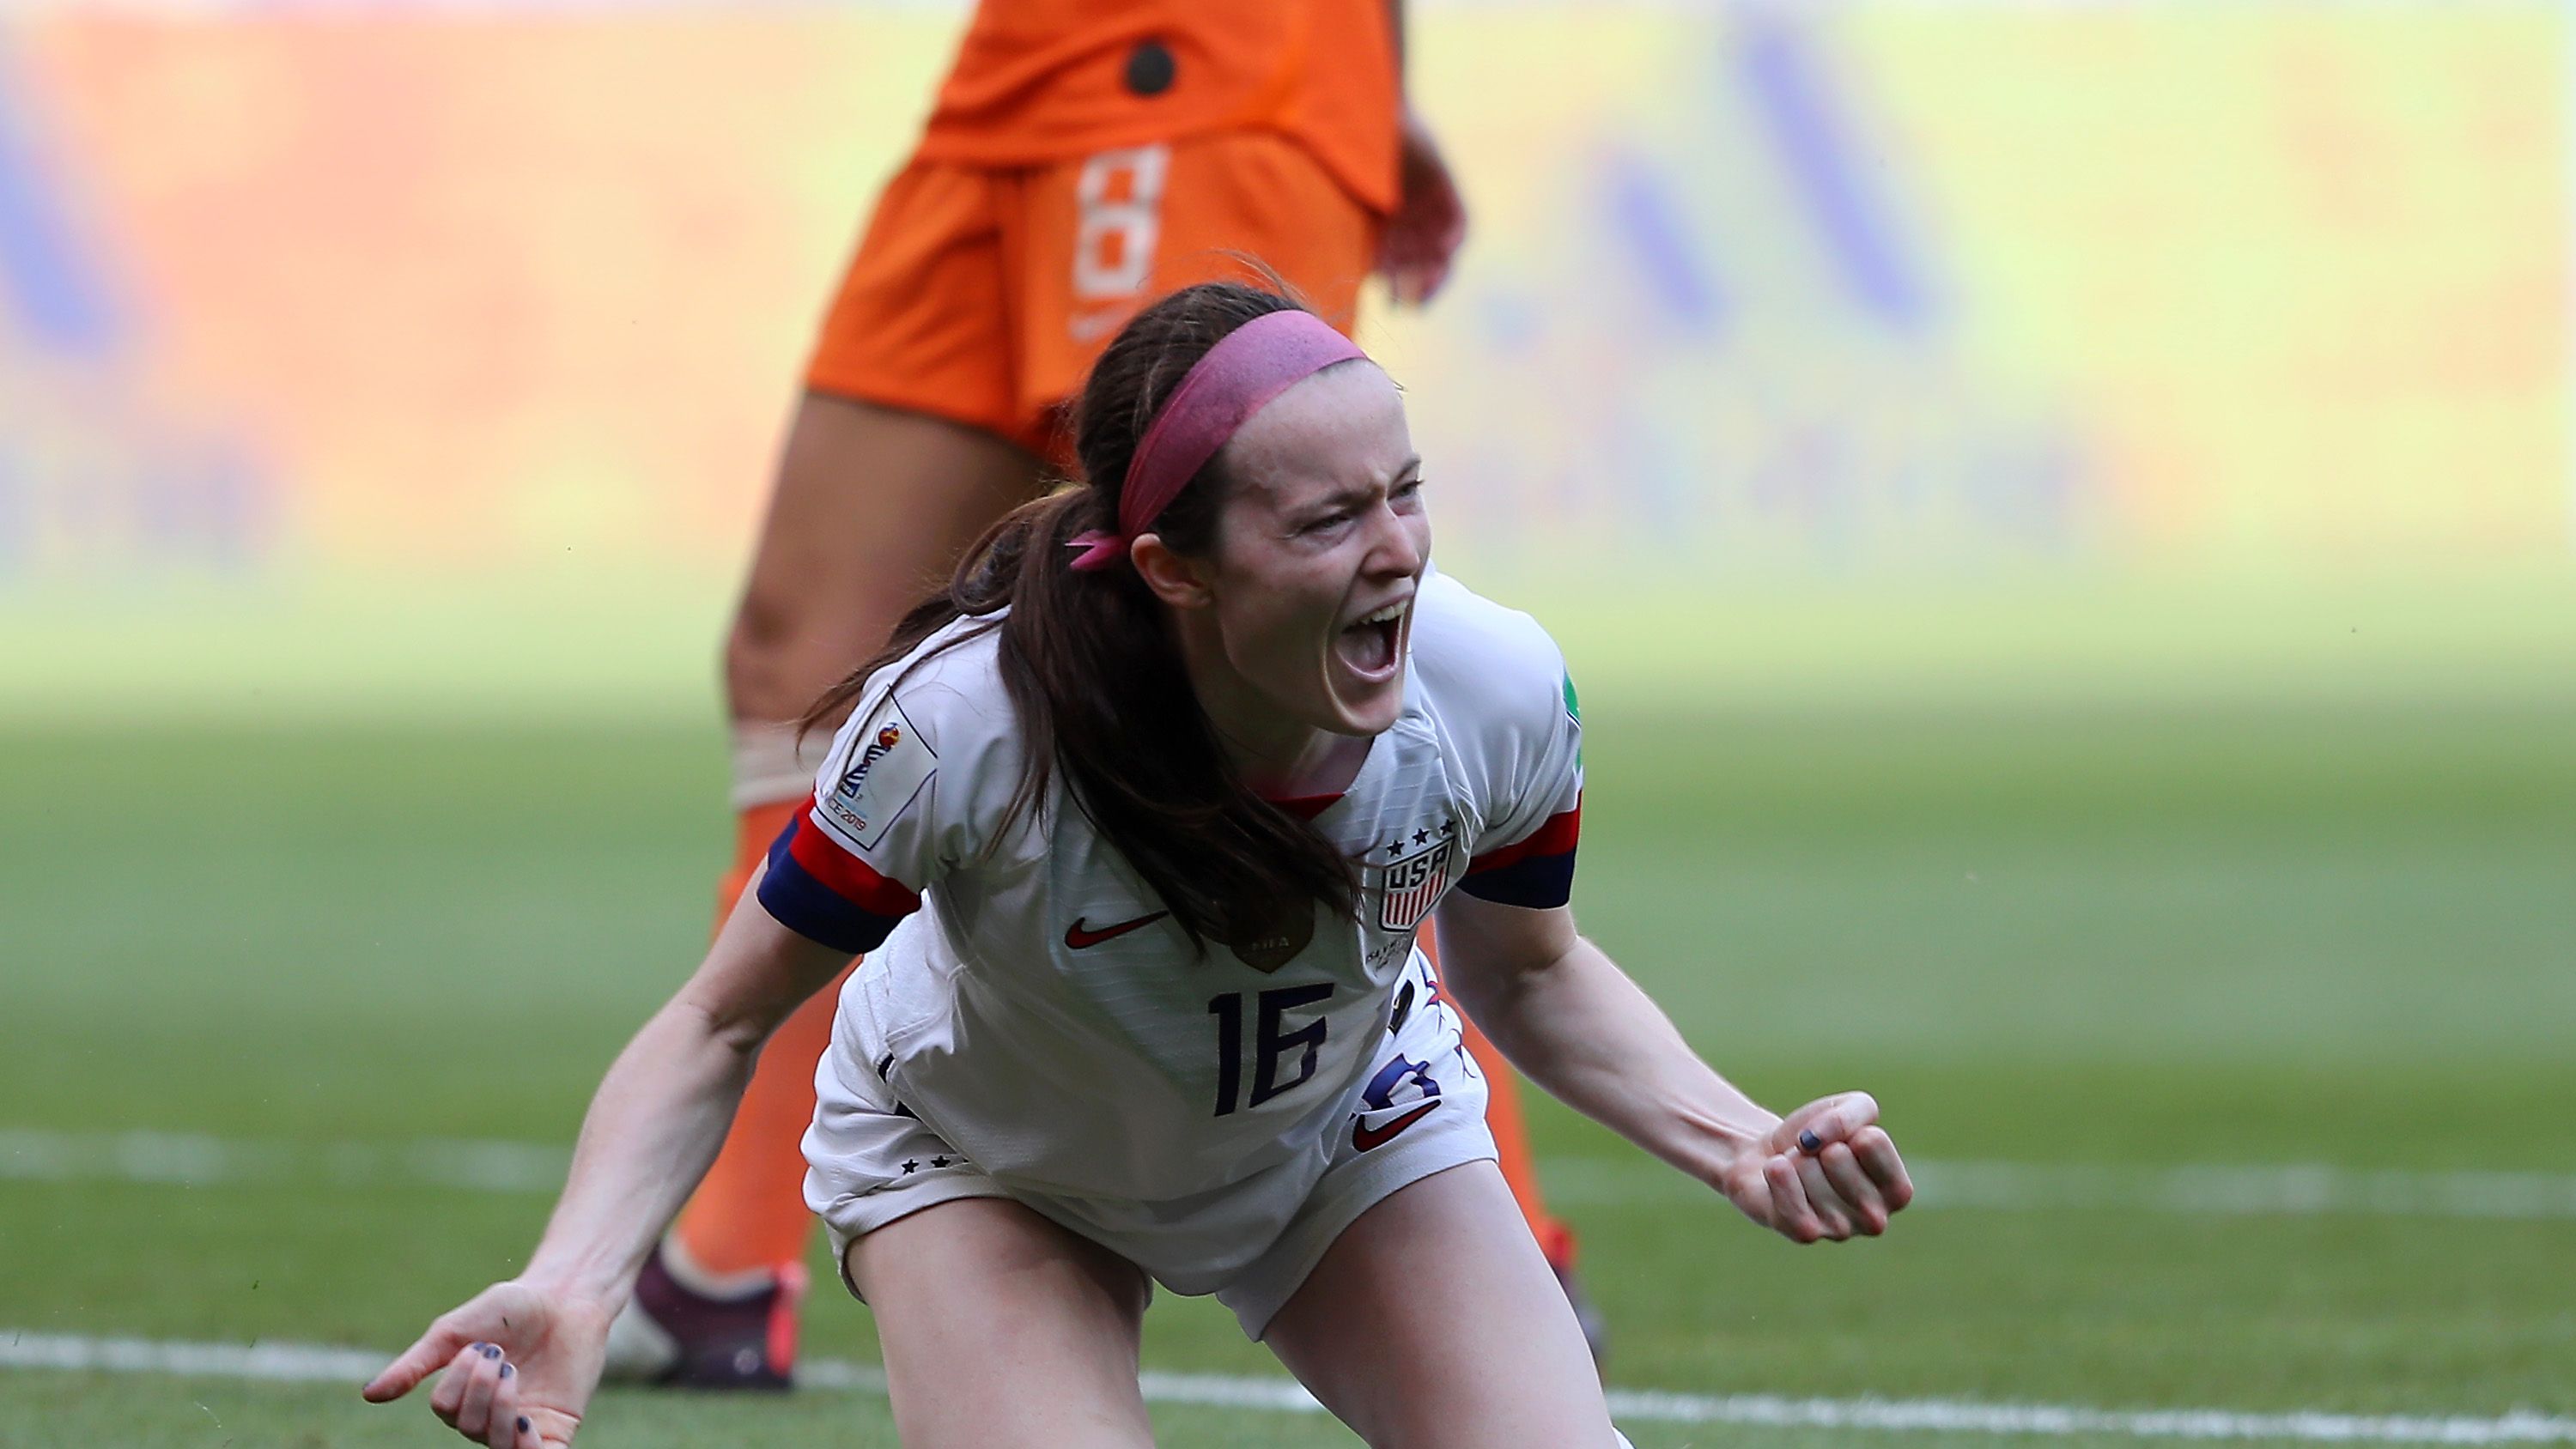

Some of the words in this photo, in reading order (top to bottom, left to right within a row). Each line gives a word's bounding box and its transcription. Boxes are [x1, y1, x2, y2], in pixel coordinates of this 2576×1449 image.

[1073, 145, 1170, 295] 8
[841, 809, 866, 831] 2019
[1389, 845, 1449, 888] USA
[1208, 983, 1334, 1116] 16
